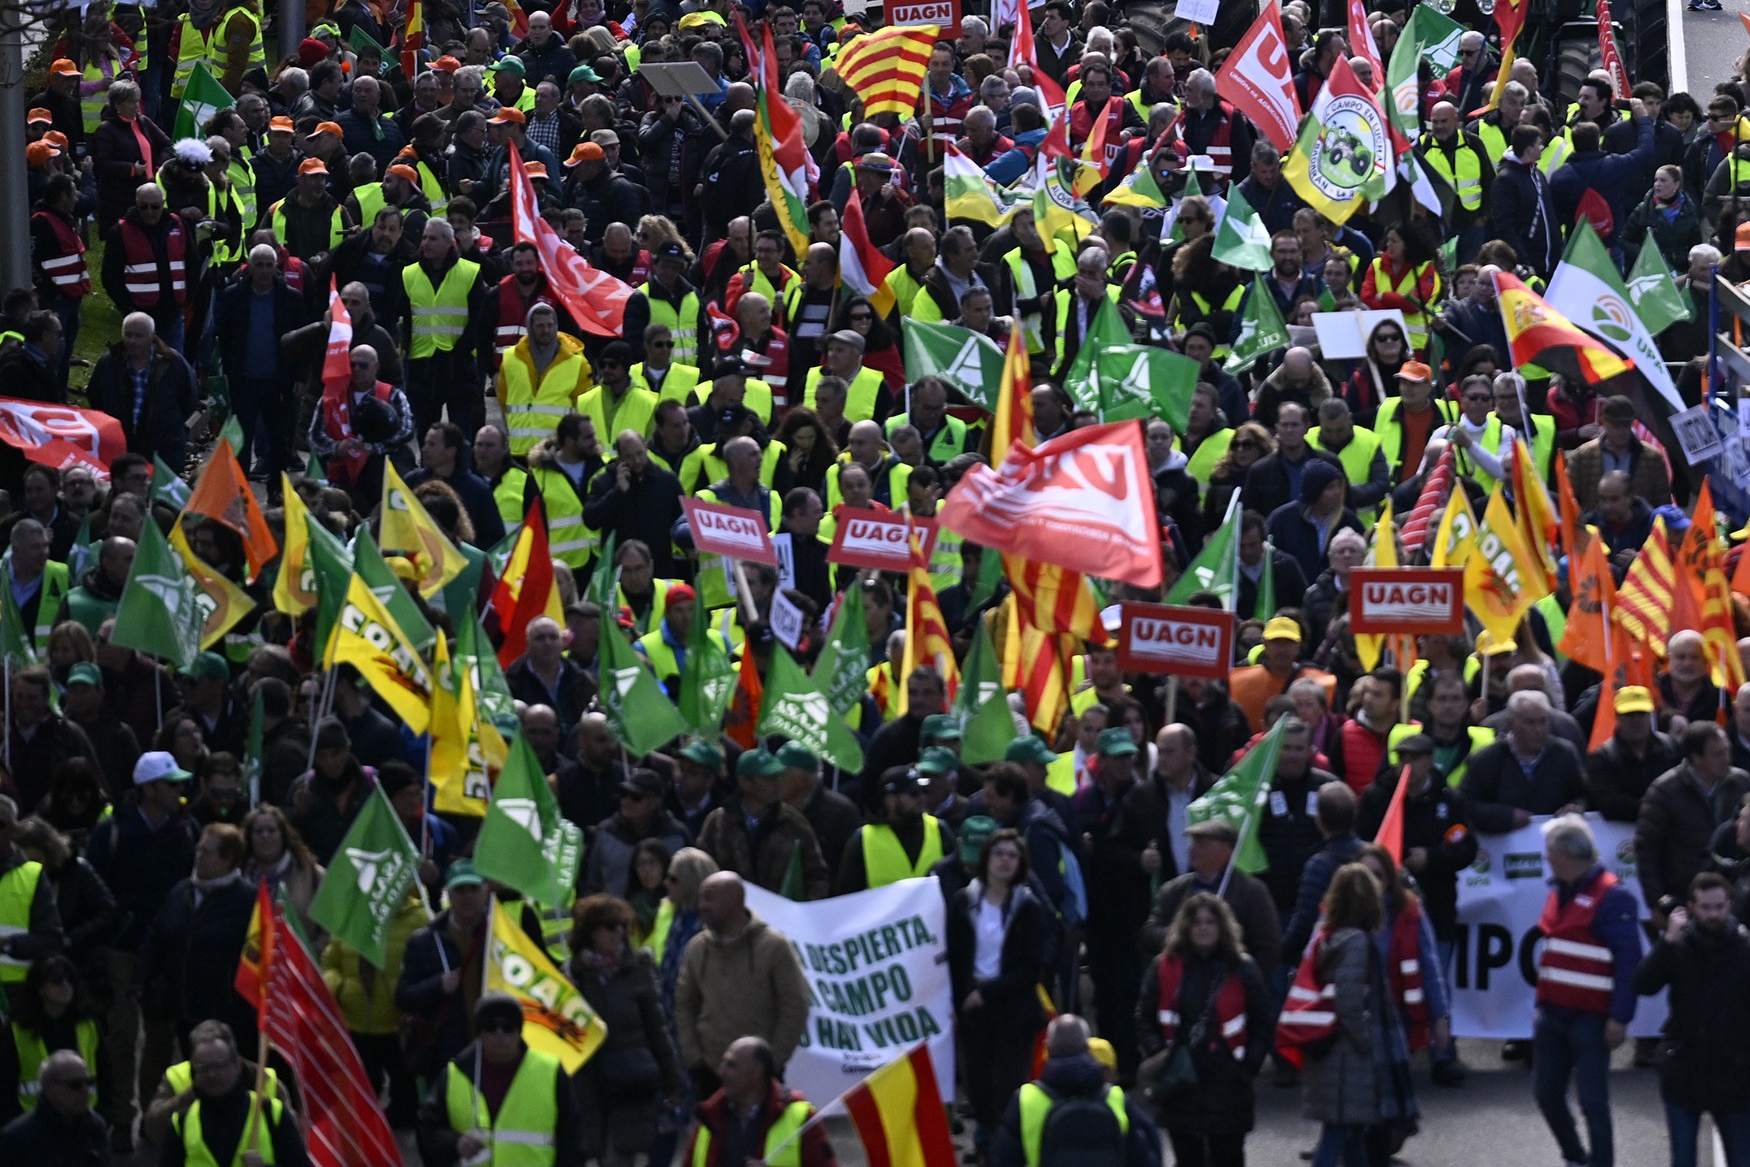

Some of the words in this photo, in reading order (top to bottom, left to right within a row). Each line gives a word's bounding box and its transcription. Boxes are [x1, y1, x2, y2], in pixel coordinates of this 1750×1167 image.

[895, 4, 951, 24] UAGN
[1331, 99, 1363, 114] CAMPO
[1364, 107, 1375, 123] EN
[699, 514, 758, 537] UAGN
[1366, 587, 1449, 605] UAGN
[1135, 619, 1218, 648] UAGN
[804, 915, 938, 976] DESPIERTA,
[816, 962, 913, 1017] CAMPO
[816, 1015, 863, 1052] HAY
[863, 1006, 943, 1048] VIDA
